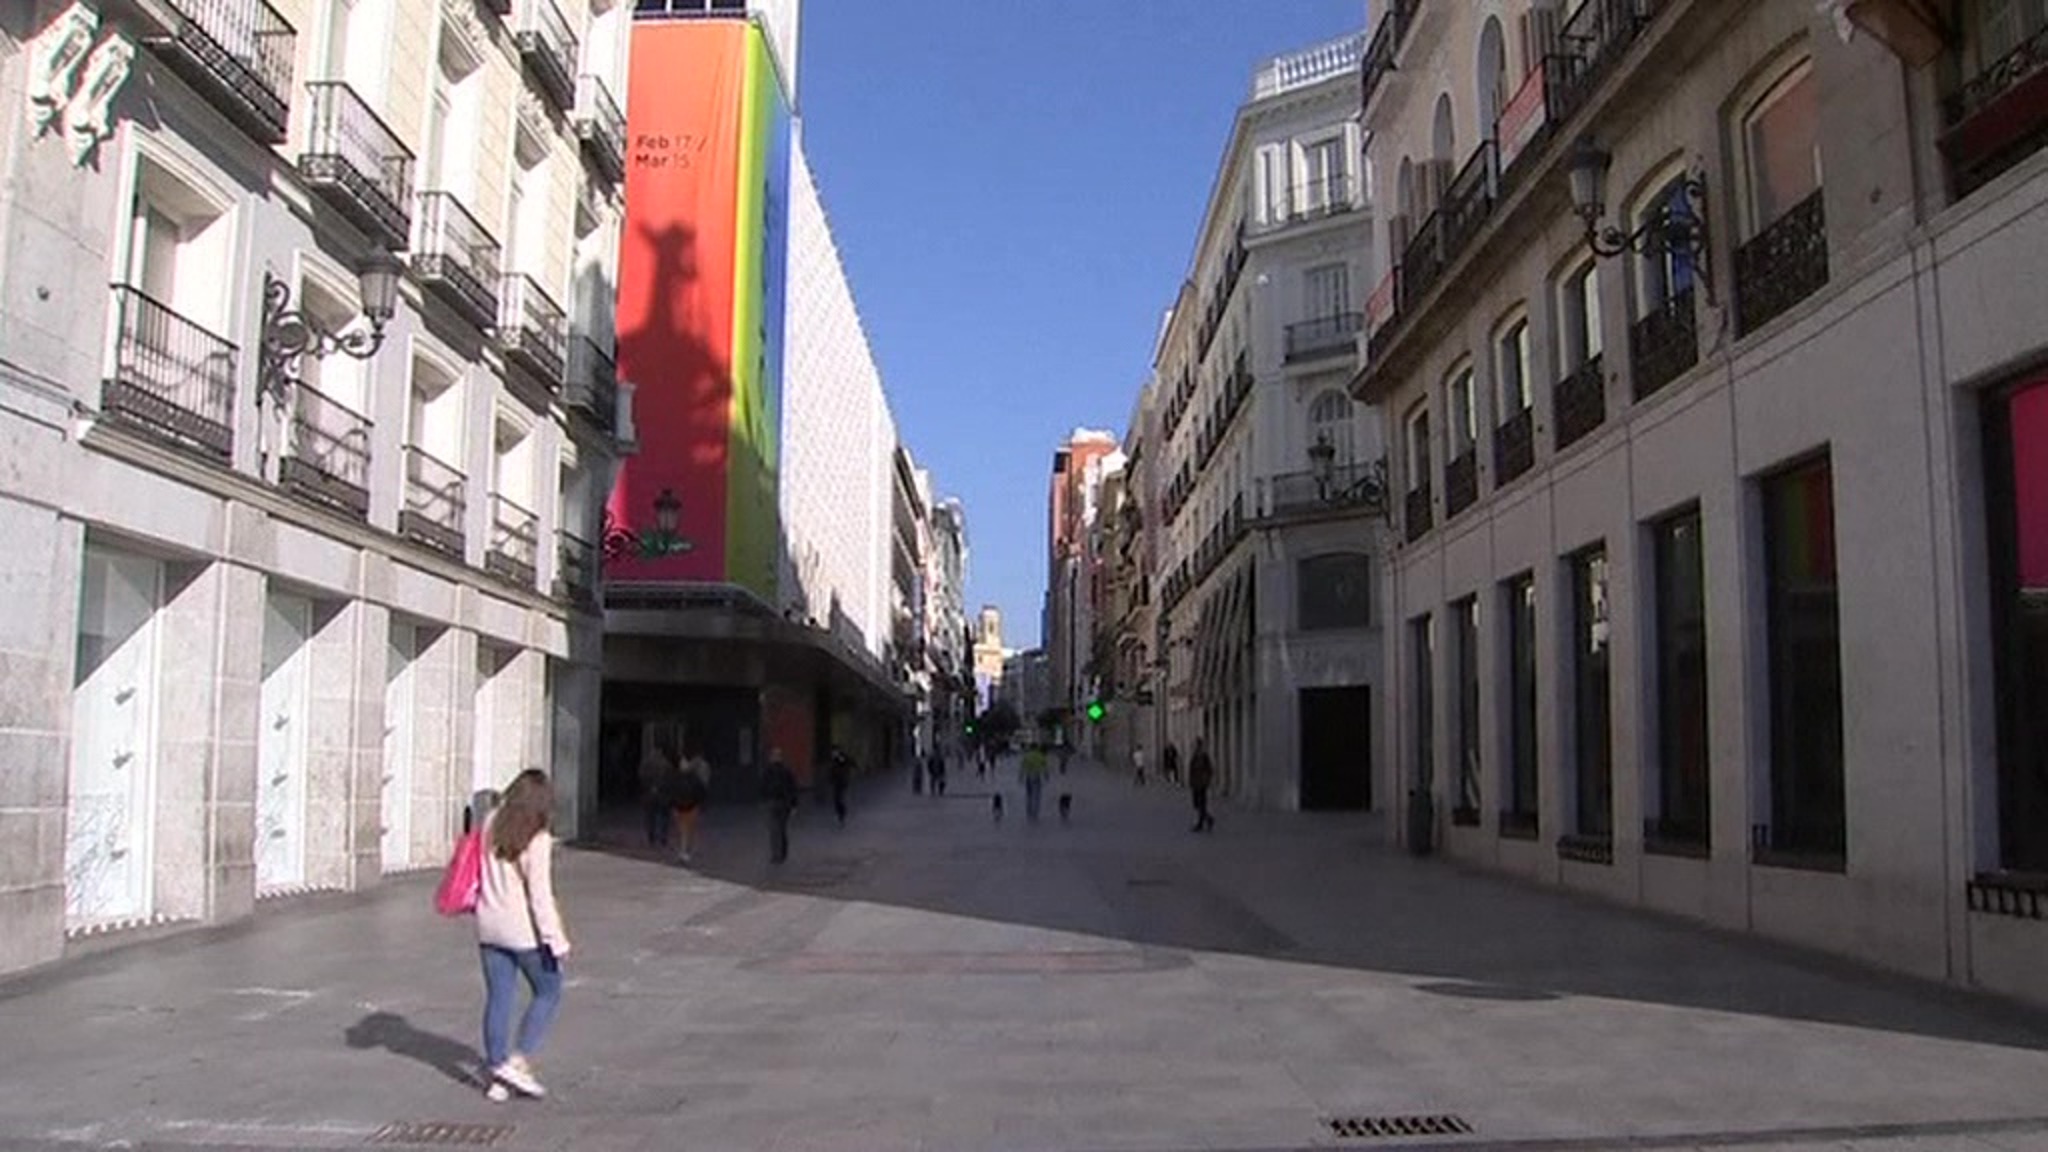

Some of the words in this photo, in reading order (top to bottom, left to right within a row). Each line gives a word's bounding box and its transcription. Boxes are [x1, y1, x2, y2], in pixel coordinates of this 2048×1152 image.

[637, 134, 669, 149] Feb
[674, 134, 692, 148] 17
[635, 153, 668, 168] Mar
[673, 154, 690, 169] 15
